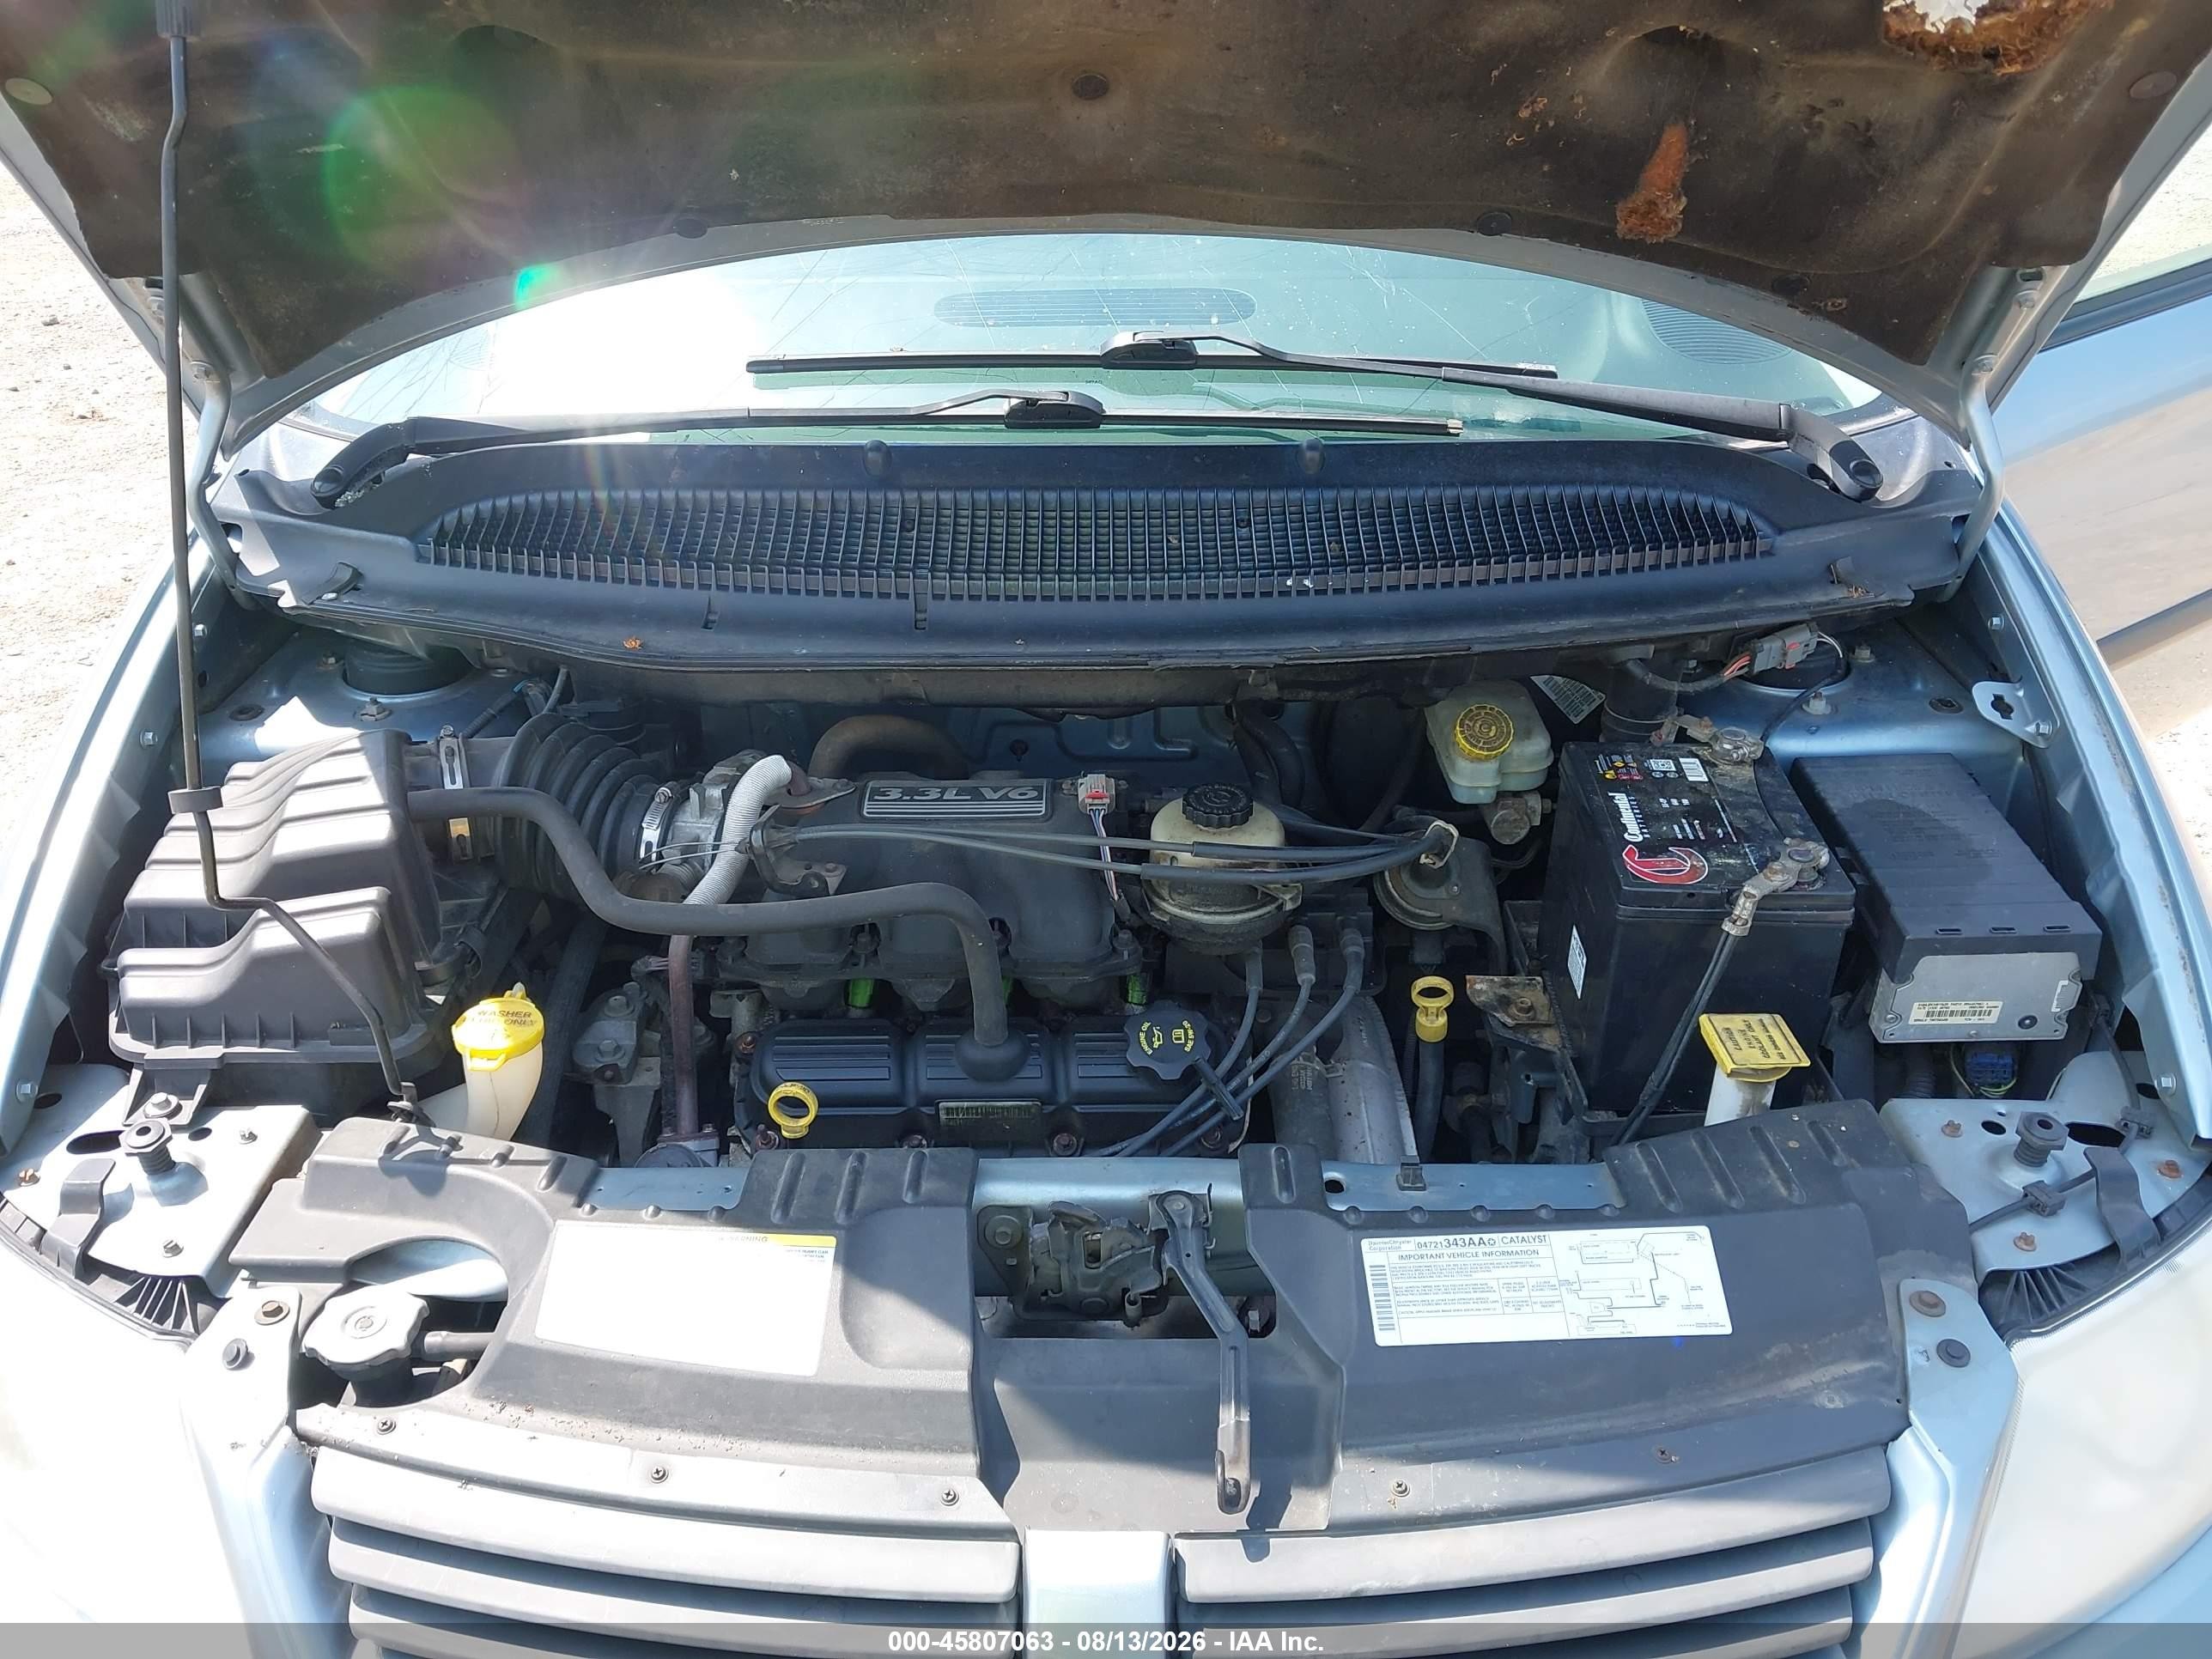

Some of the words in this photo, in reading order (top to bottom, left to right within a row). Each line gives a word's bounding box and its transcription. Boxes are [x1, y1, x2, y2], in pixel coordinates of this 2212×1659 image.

[873, 787, 972, 800] 3.3L
[978, 787, 1039, 799] V6
[1607, 792, 1644, 842] Continental
[477, 1010, 532, 1018] WASHER
[1141, 1022, 1152, 1031] OIL
[1139, 1031, 1153, 1054] ENGINE
[1184, 1039, 1194, 1052] SAE
[726, 1235, 769, 1243] ARNING
[1501, 1235, 1547, 1245] CATALYST
[1398, 1252, 1445, 1261] IMPORTANT
[1445, 1251, 1480, 1260] VEHICLE
[1481, 1249, 1540, 1258] INFORMATION
